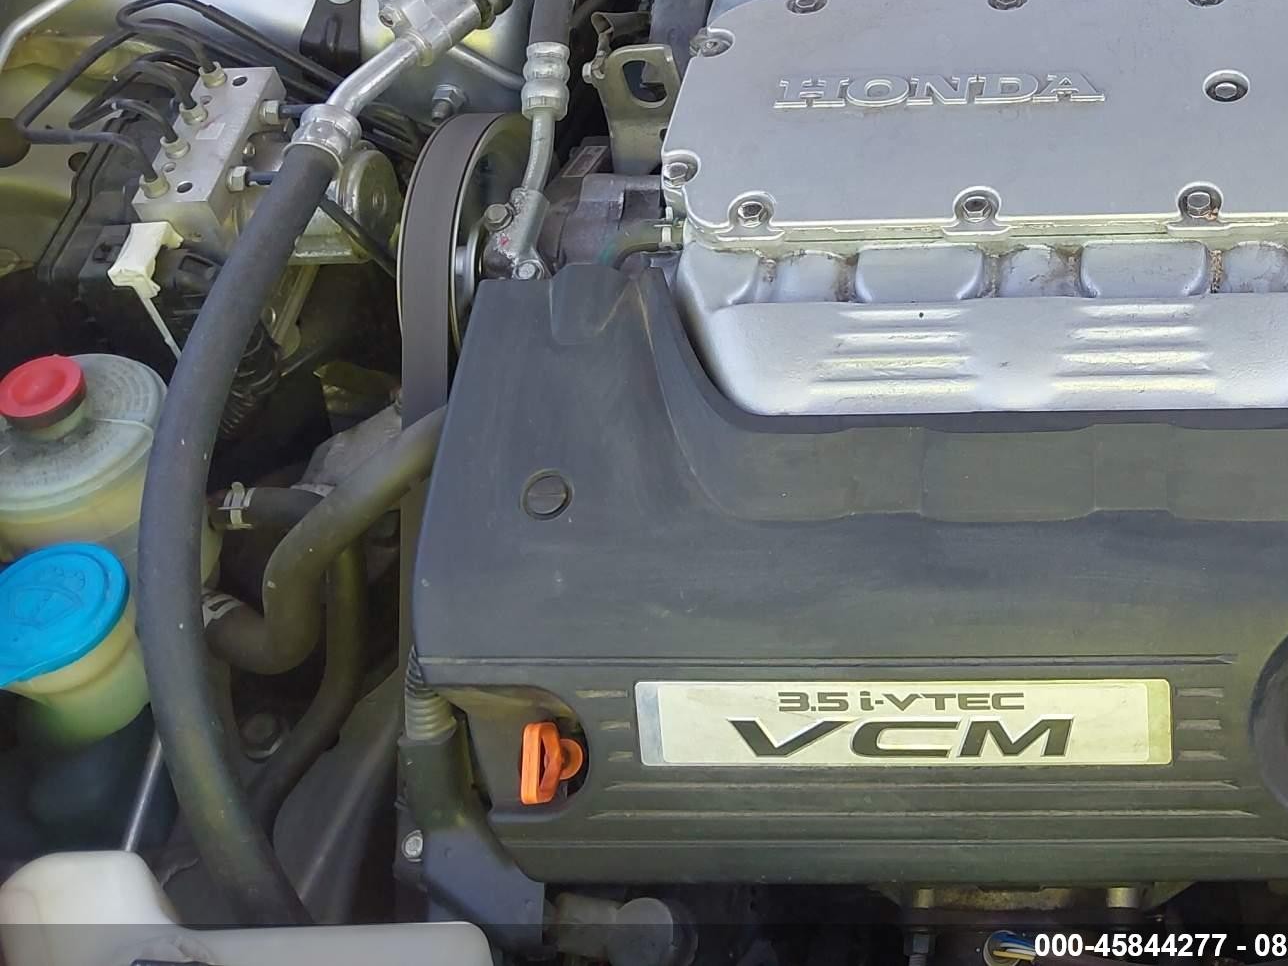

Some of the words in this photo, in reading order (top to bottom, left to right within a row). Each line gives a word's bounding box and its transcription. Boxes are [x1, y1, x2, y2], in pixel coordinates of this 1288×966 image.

[773, 73, 1105, 108] HONDA
[777, 690, 849, 713] 3.5
[860, 690, 1025, 712] i-VTEC
[727, 715, 1075, 759] VCM
